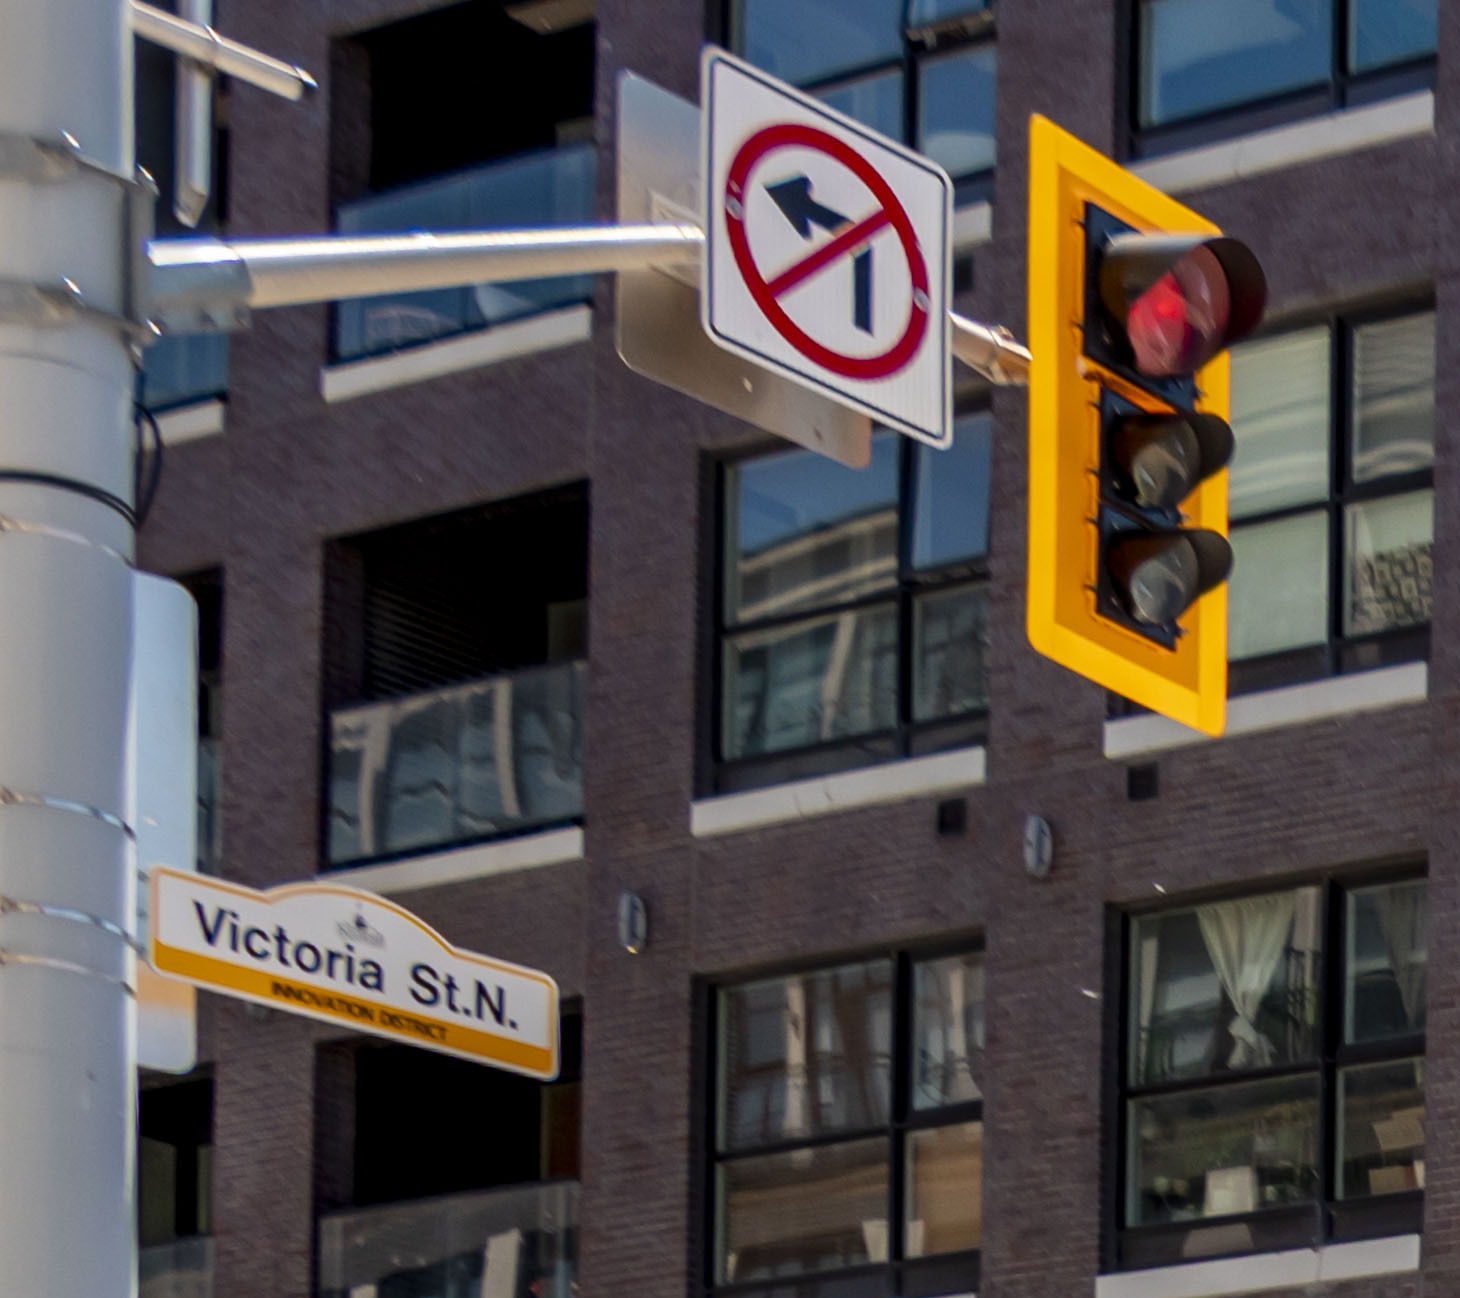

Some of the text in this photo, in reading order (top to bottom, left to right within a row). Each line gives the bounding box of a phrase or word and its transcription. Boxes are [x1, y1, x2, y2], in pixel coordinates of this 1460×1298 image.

[192, 899, 384, 993] Victoria
[271, 980, 448, 1042] INNOVATION DISTRICT
